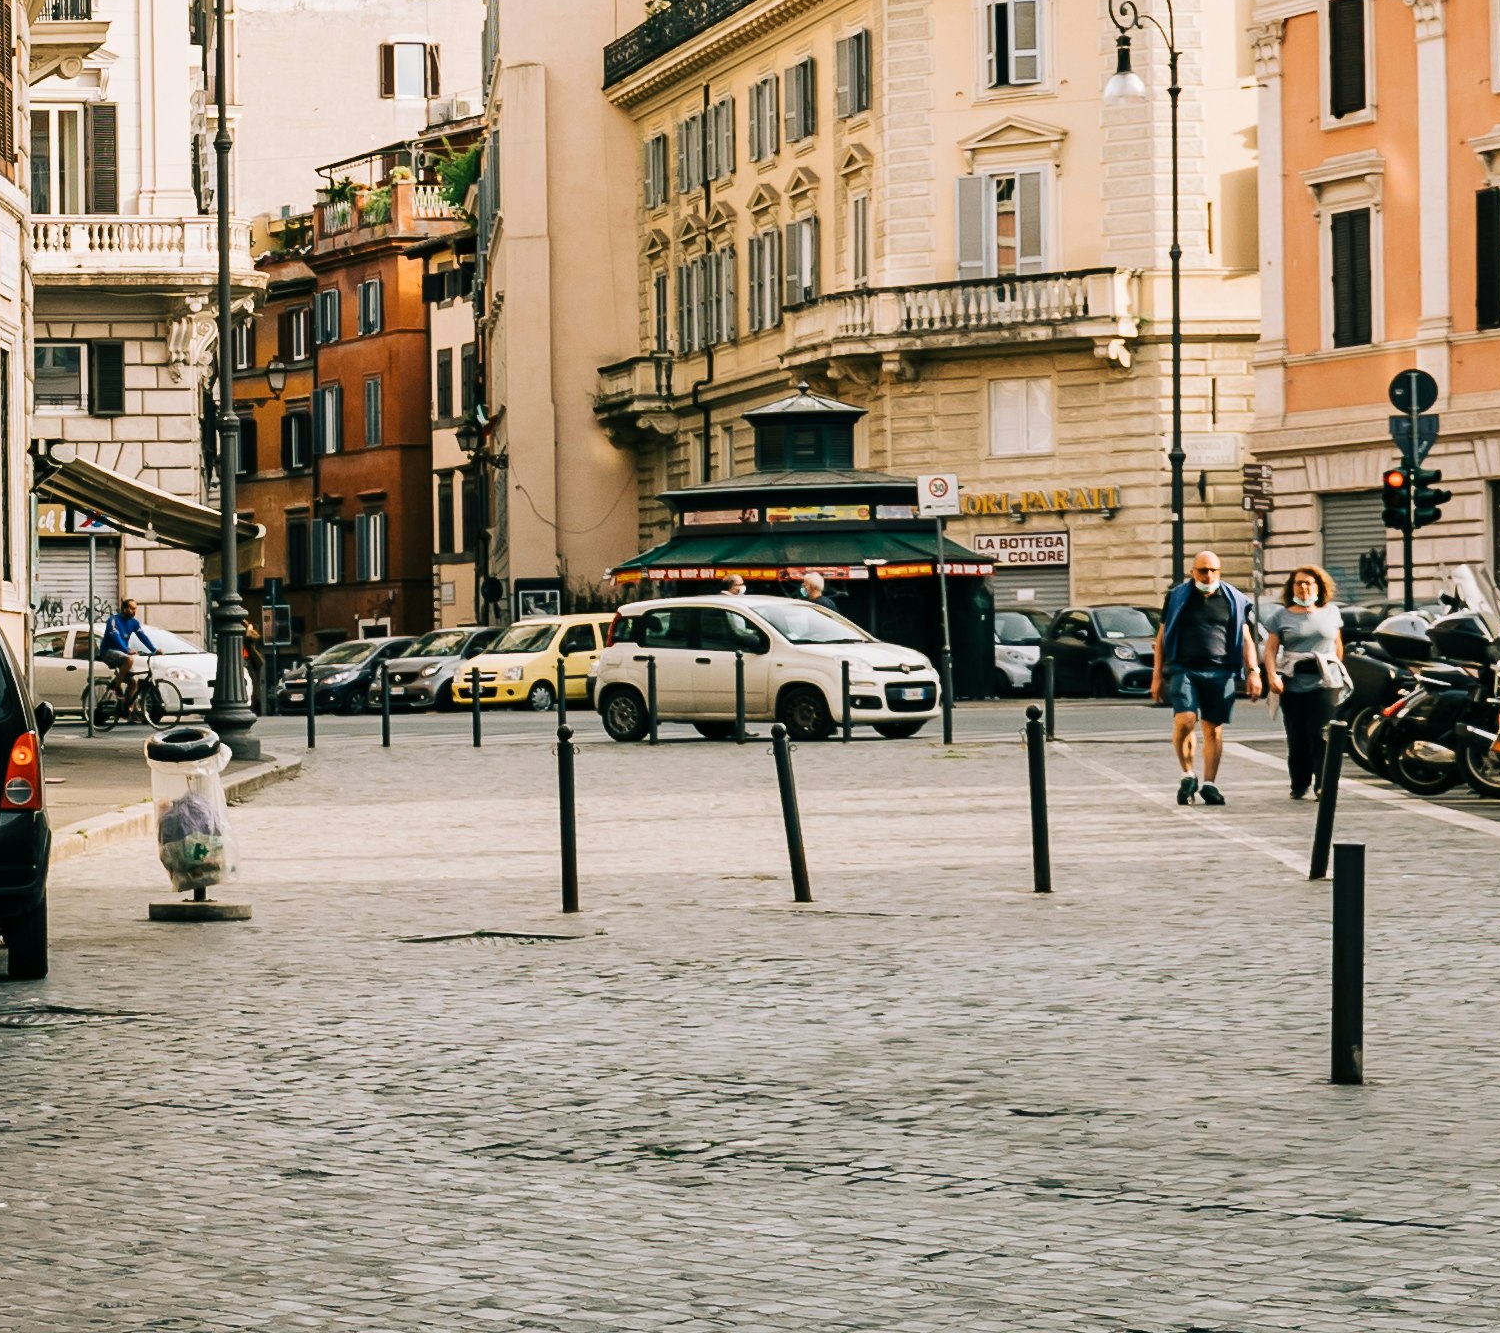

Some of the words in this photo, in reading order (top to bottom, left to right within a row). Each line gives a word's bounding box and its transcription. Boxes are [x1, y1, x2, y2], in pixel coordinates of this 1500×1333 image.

[933, 483, 945, 493] 30
[960, 485, 1119, 515] ORI-PARATI
[977, 538, 995, 550] LA
[999, 536, 1065, 550] BOTTEGA
[1008, 550, 1065, 563] COLORE
